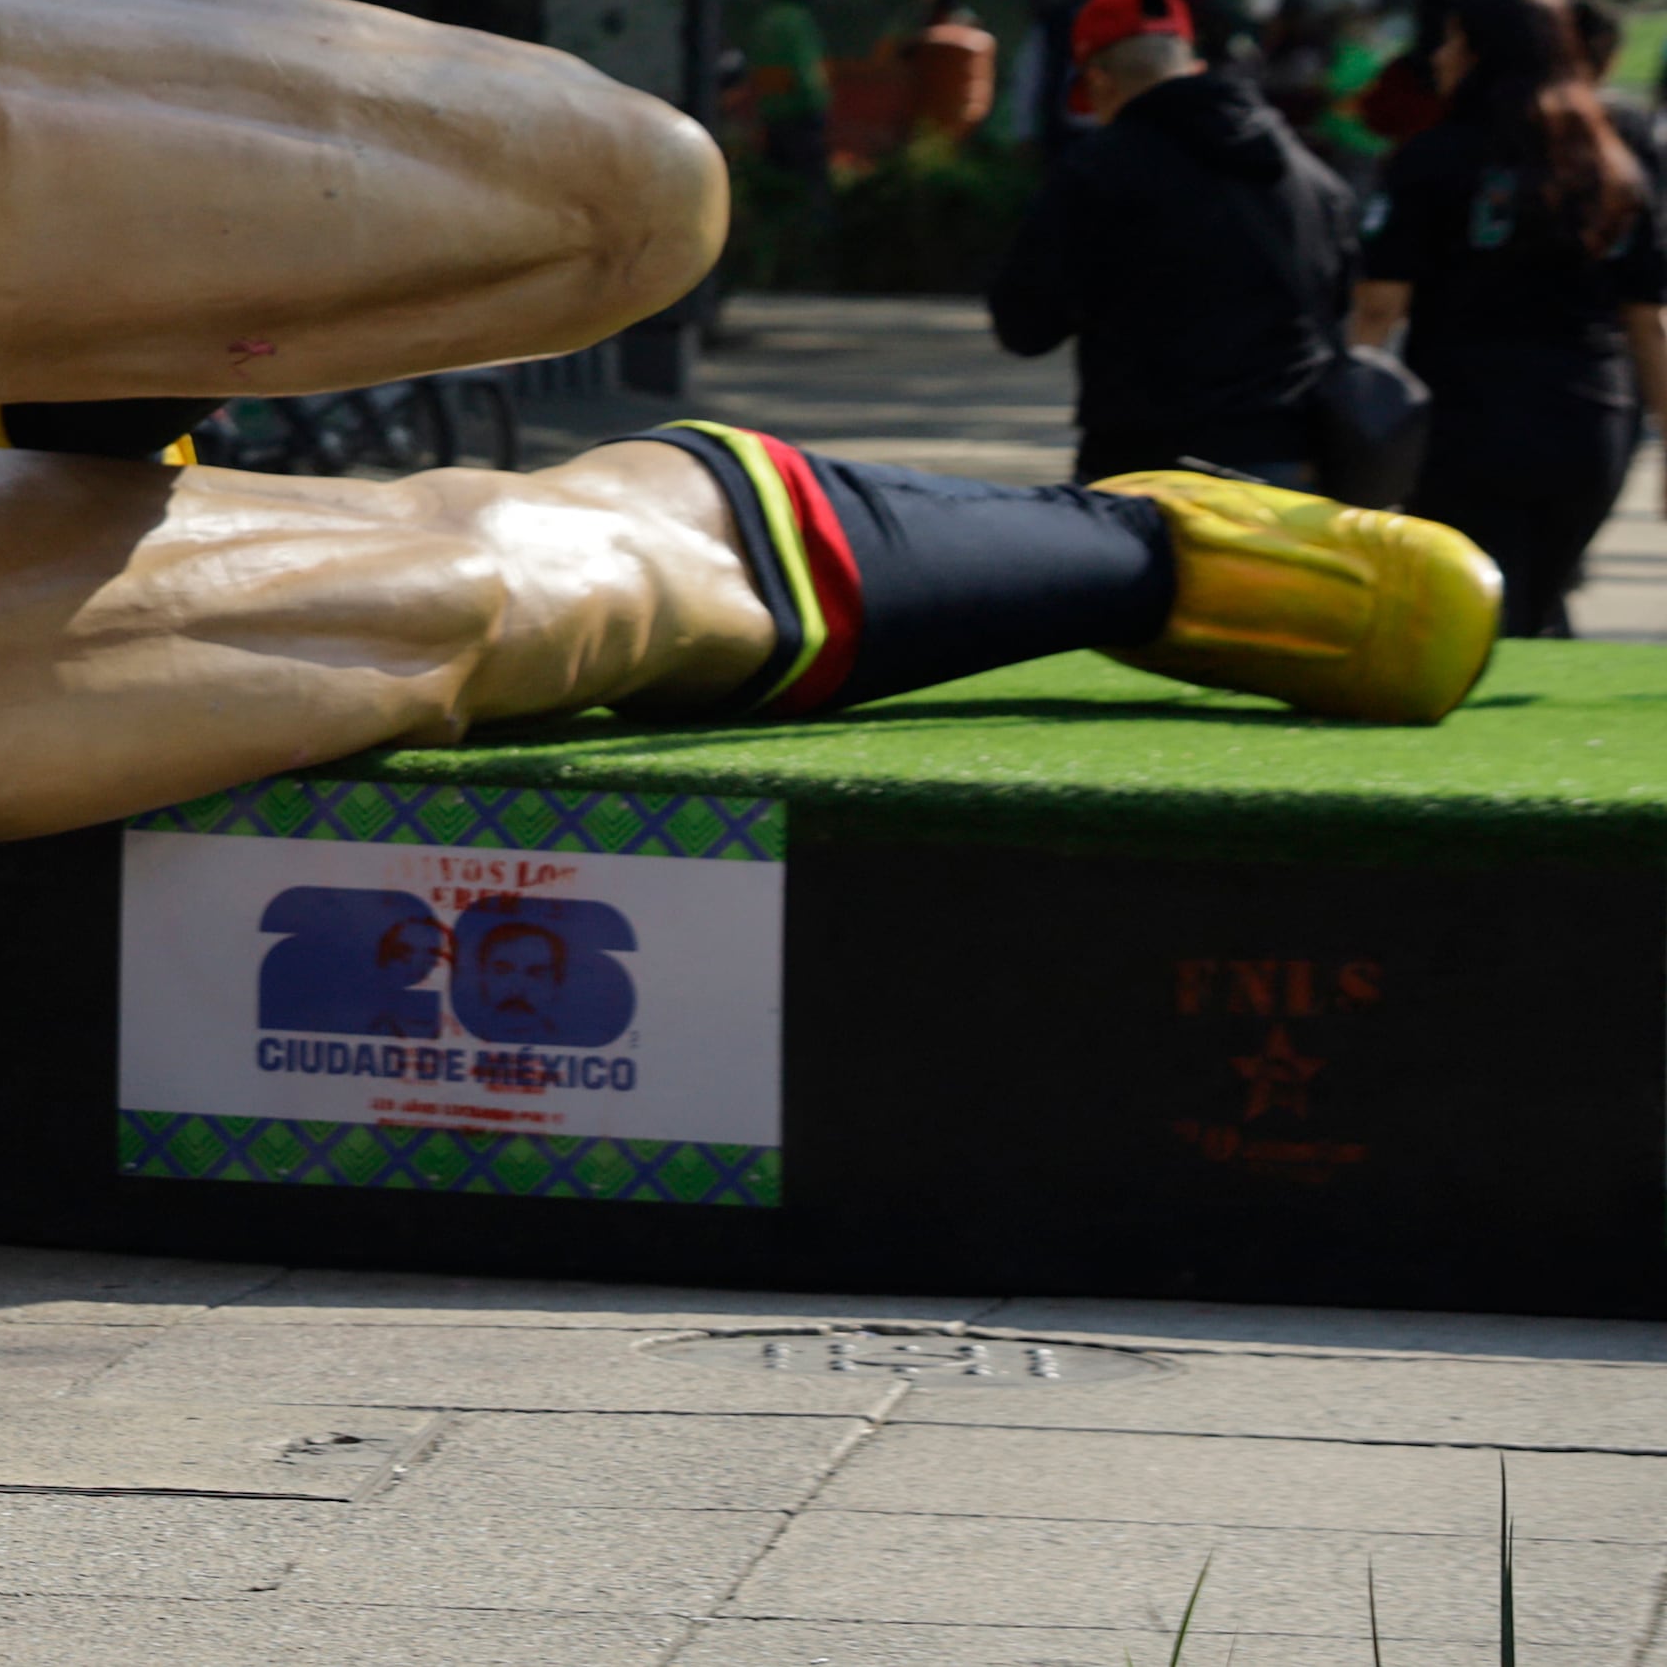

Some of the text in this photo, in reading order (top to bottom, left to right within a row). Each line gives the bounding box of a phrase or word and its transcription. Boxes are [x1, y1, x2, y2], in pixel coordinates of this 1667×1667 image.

[260, 886, 637, 1046] 26
[257, 1036, 406, 1078] CIUDAD
[415, 1043, 469, 1082] DE
[474, 1045, 638, 1092] MÉXICO
